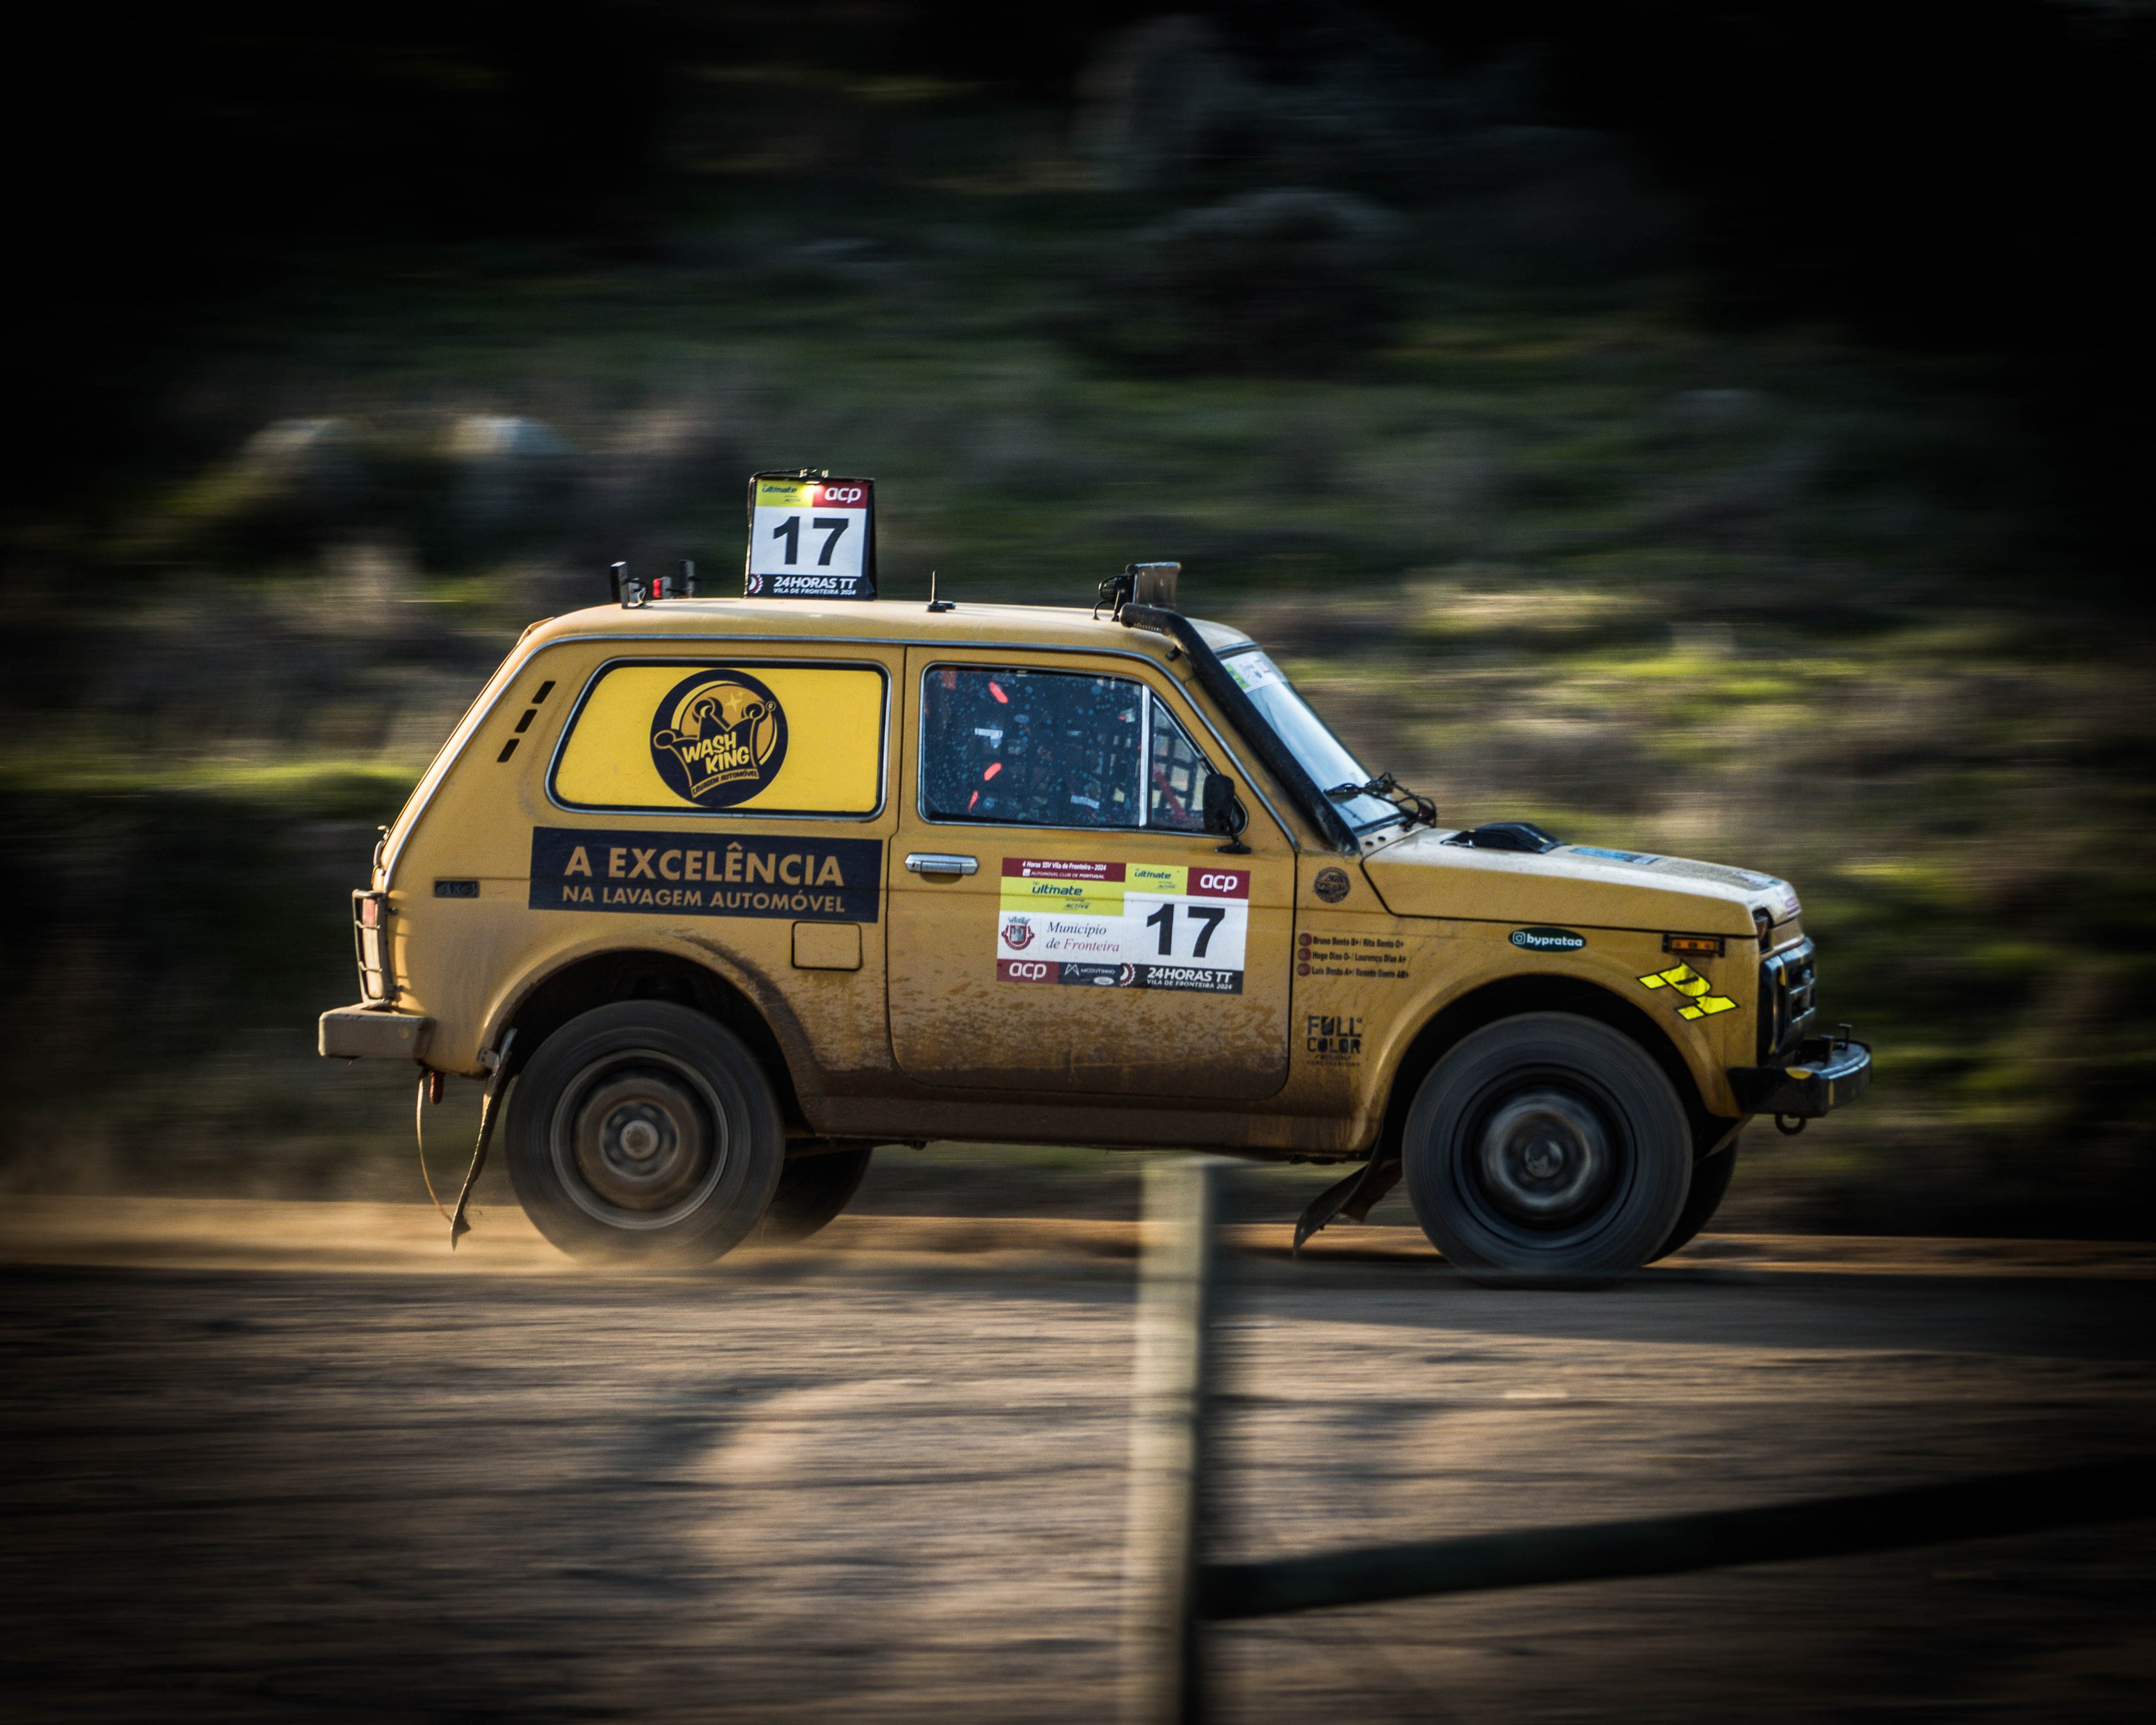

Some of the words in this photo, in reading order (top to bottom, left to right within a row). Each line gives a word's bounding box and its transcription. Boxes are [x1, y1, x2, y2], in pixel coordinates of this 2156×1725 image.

[825, 487, 862, 504] acp
[773, 515, 849, 566] 17
[839, 578, 857, 589] TT
[682, 731, 736, 763] WASH
[705, 746, 750, 775] KING
[692, 777, 719, 795] LAVAGEM
[564, 846, 593, 877] A
[608, 841, 845, 886] EXCELÊNCIA
[1134, 870, 1171, 879] ultimate
[1200, 874, 1237, 892] acp
[1032, 884, 1083, 895] ultimate
[562, 885, 594, 902] NA
[602, 888, 702, 906] LAVAGEM
[708, 889, 845, 913] AUTOMÓVEL
[1047, 921, 1107, 937] Município
[1146, 903, 1225, 958] 17
[1046, 938, 1060, 949] de
[1064, 938, 1119, 952] Fronteira
[1363, 938, 1375, 947] Rita
[1527, 933, 1582, 946] byprataa
[1312, 951, 1327, 961] Hugo
[1329, 952, 1342, 960] Dias
[1009, 963, 1047, 980] acp
[1215, 972, 1232, 983] TT
[1307, 1015, 1361, 1037] FULL
[1306, 1037, 1361, 1055] COLOR
